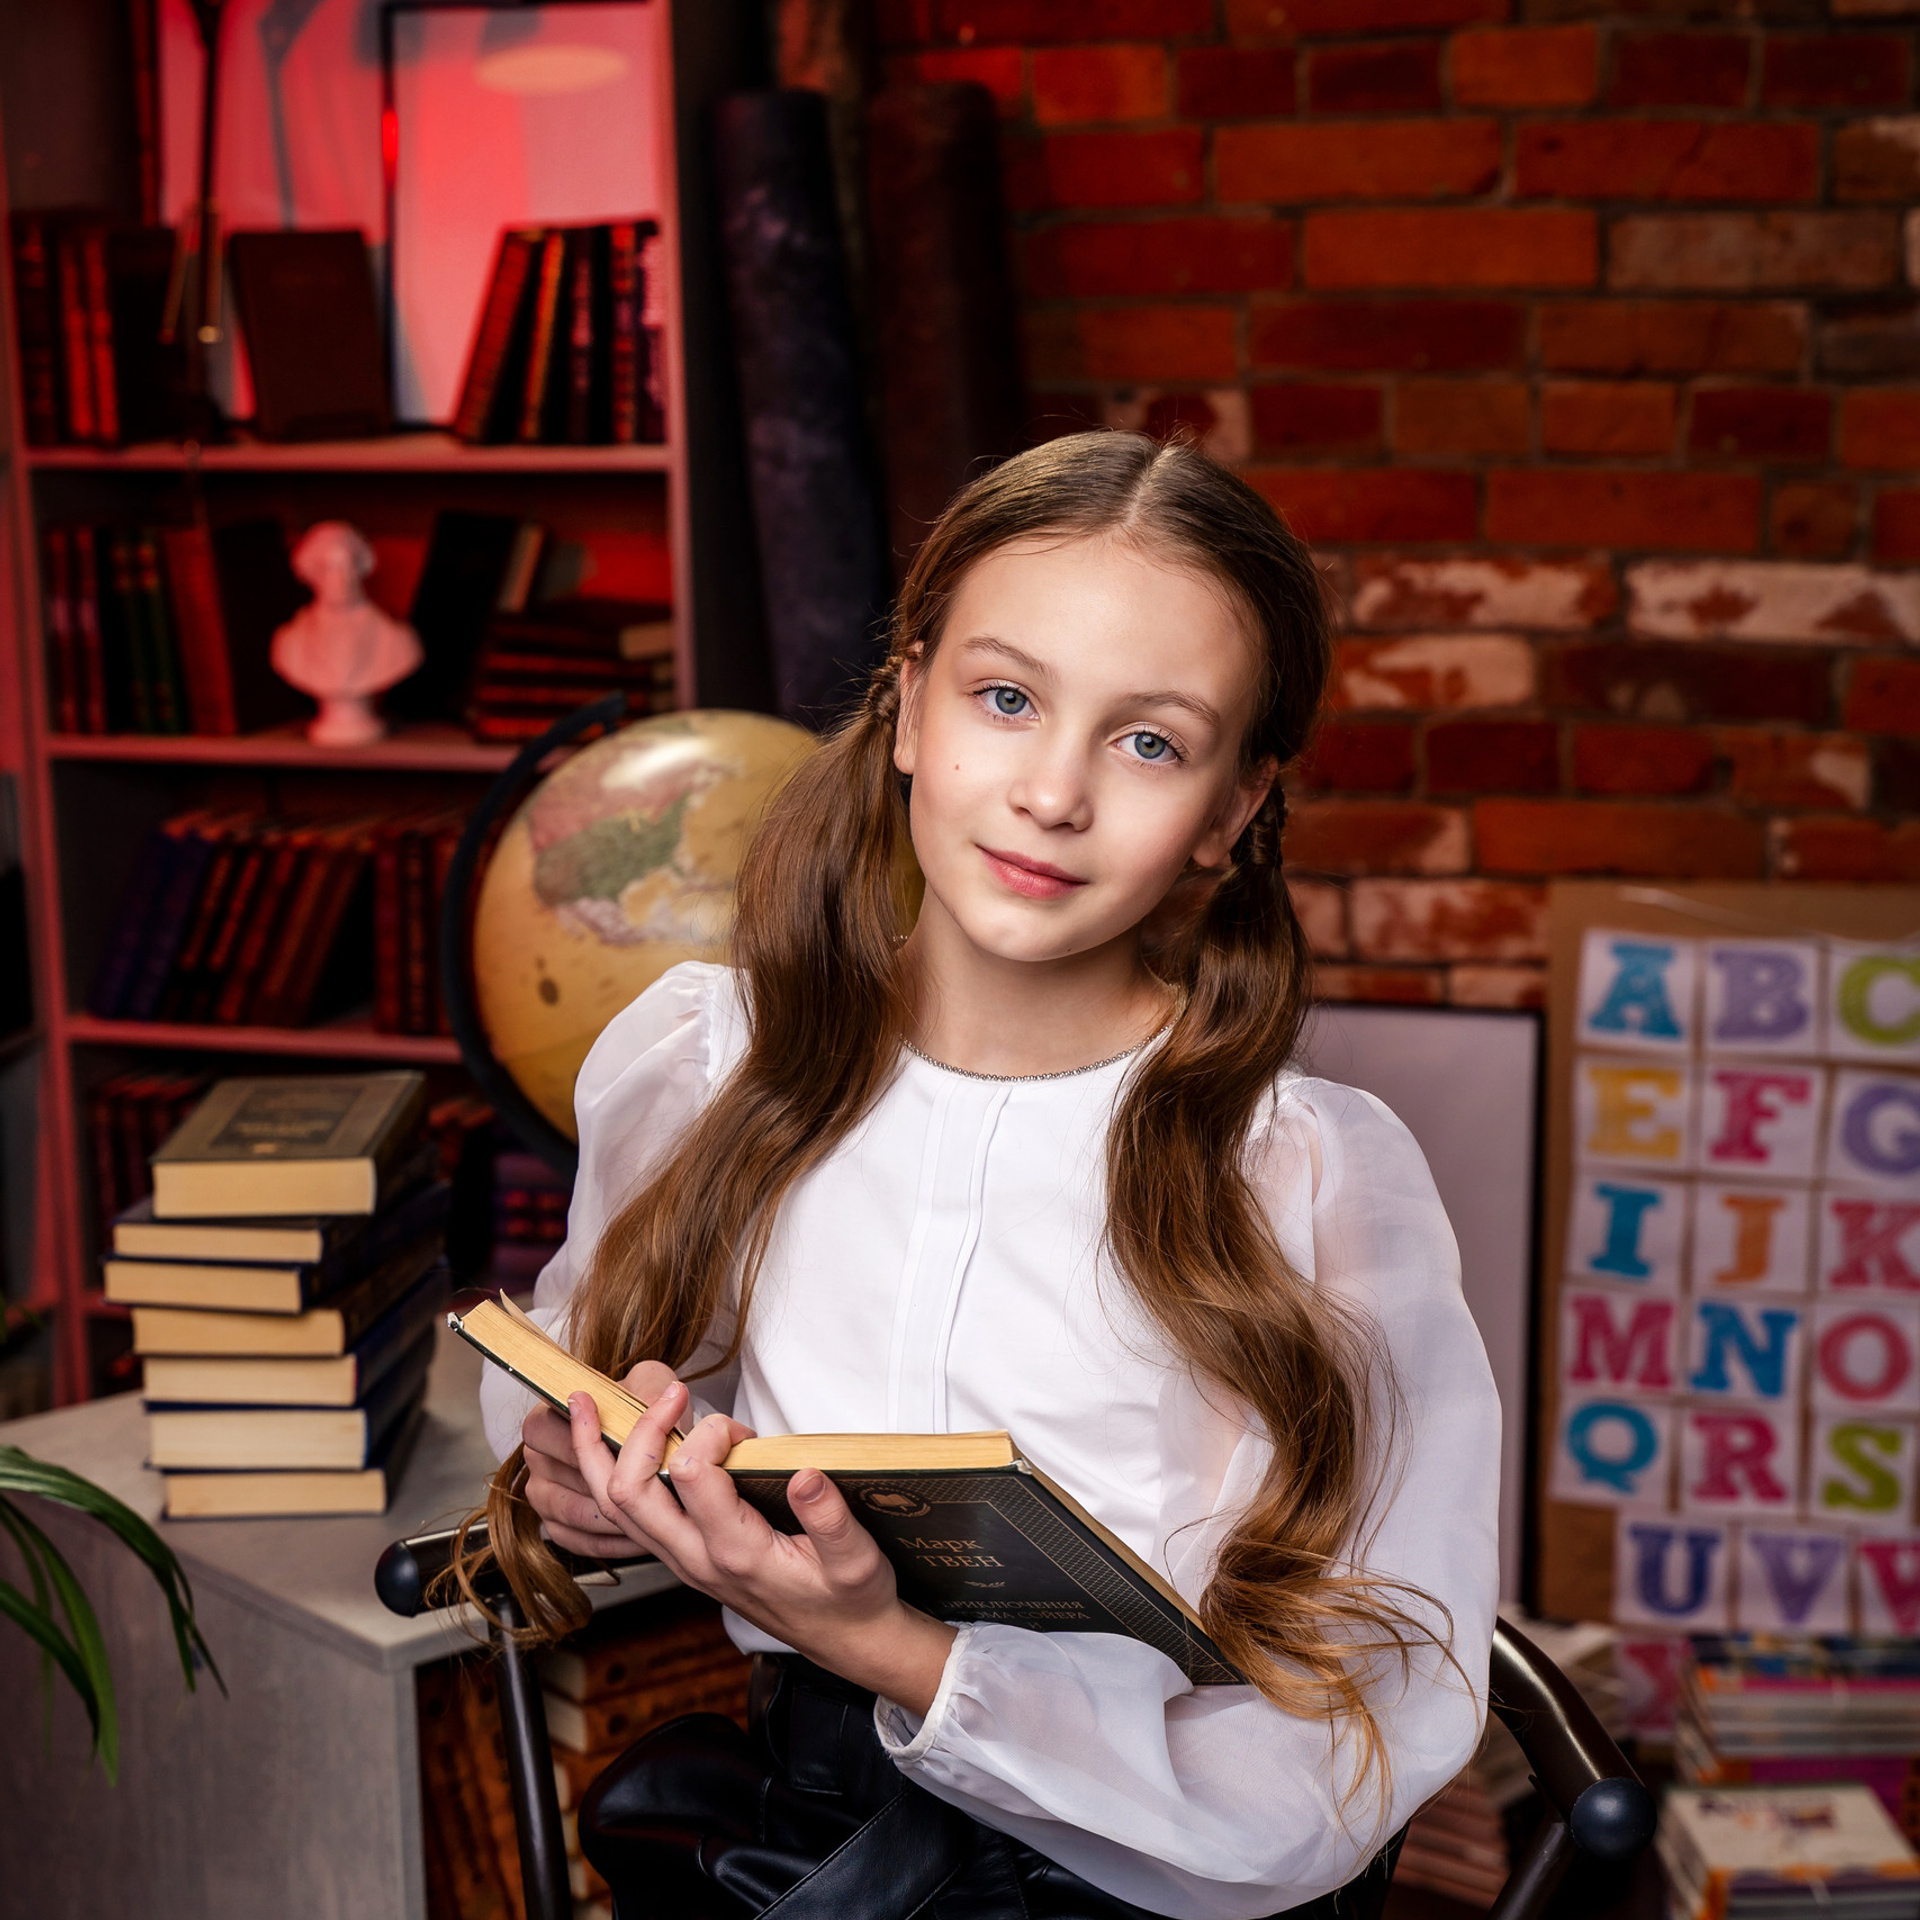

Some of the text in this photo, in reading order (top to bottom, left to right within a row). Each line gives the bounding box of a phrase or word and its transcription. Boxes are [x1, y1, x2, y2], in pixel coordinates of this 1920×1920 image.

[1589, 941, 1920, 1047] A B C
[1586, 1066, 1920, 1177] E F G
[1589, 1182, 1920, 1290] I J K
[1568, 1294, 1912, 1401] M N O
[1567, 1399, 1902, 1511] Q R S
[896, 1537, 984, 1553] Марк
[915, 1554, 1005, 1568] ТВЕН
[1630, 1524, 1719, 1616] U
[1751, 1536, 1842, 1623] V
[1017, 1610, 1092, 1620] СОЙЕРА
